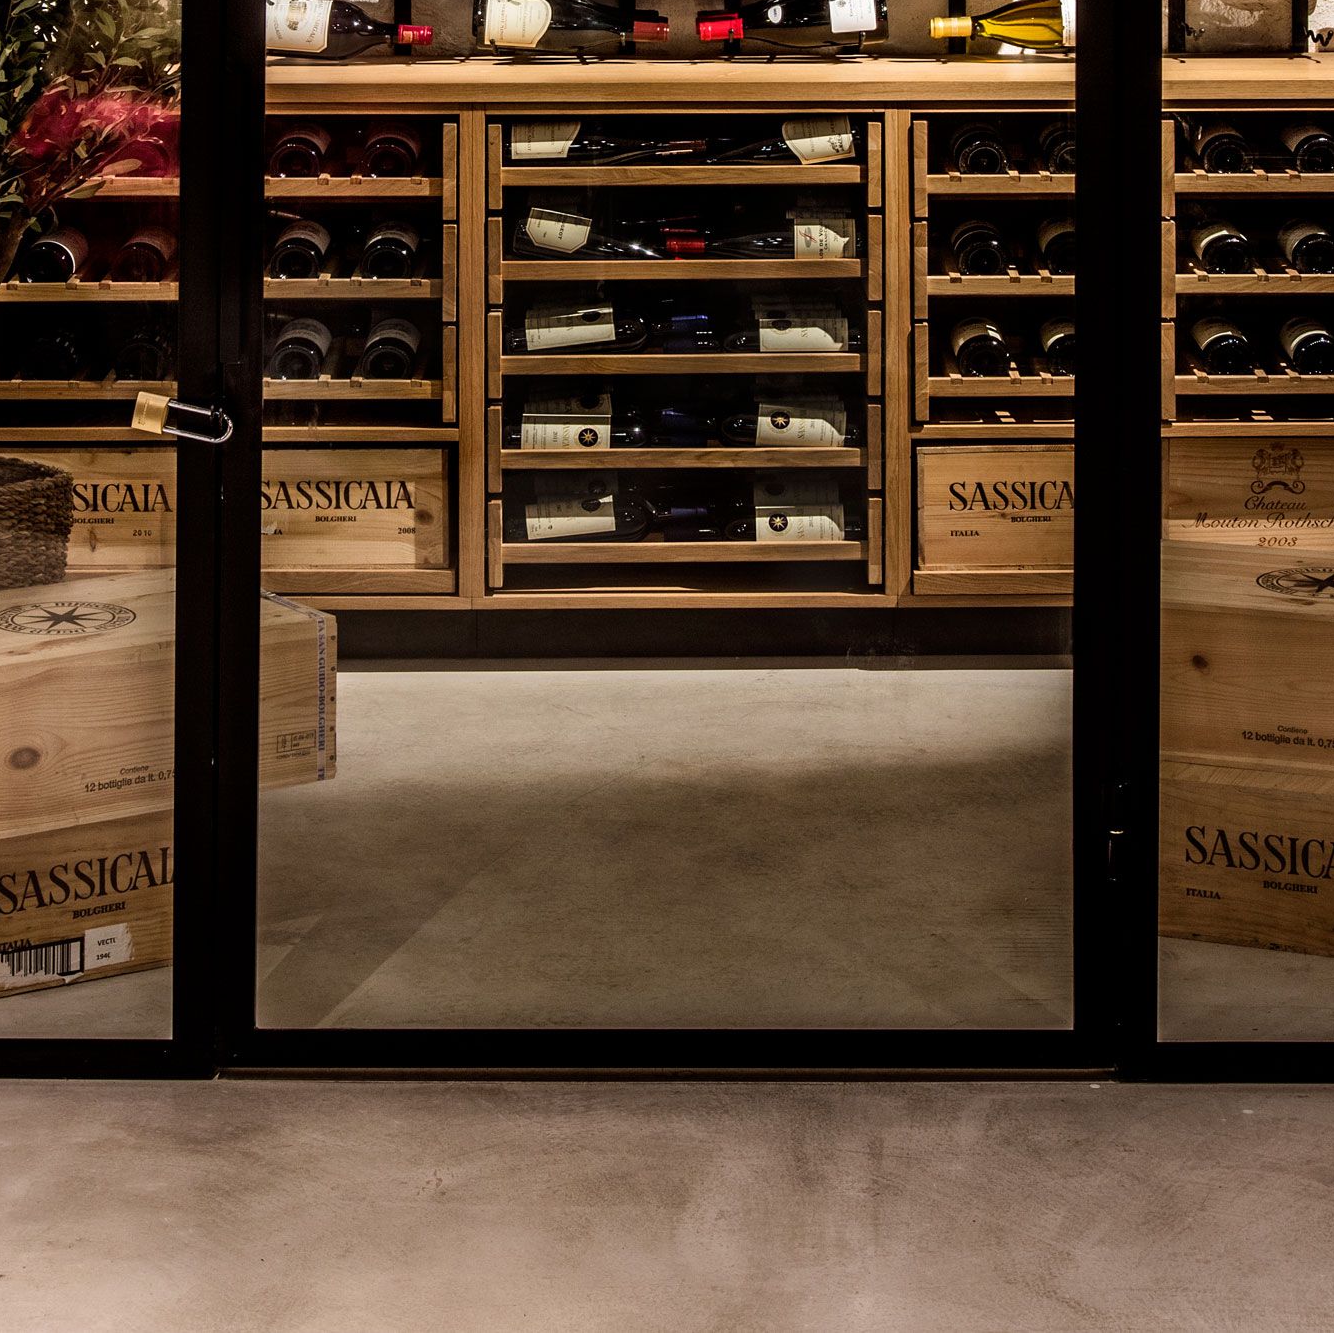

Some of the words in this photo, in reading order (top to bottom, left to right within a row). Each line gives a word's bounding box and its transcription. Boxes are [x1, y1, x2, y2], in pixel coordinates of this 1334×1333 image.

[72, 484, 173, 512] SICAIA
[261, 480, 415, 510] SASSICAIA
[949, 480, 1074, 511] SASSICA
[1181, 513, 1260, 529] Mouton
[397, 527, 416, 535] 2008
[1258, 536, 1298, 547] 2003
[318, 632, 326, 655] SAN
[318, 657, 326, 751] GUIDO-BOLGHERI
[1242, 731, 1253, 740] 12
[1255, 732, 1290, 745] bottiglie
[1293, 736, 1305, 745] da
[120, 765, 149, 775] Contiene
[85, 782, 96, 792] 12
[98, 778, 132, 790] bottiglie
[134, 775, 146, 784] da
[158, 769, 175, 780] 0,7
[1186, 888, 1221, 900] ITALIA
[1263, 880, 1318, 894] BOLGHERI
[72, 901, 126, 919] BOLGHERI
